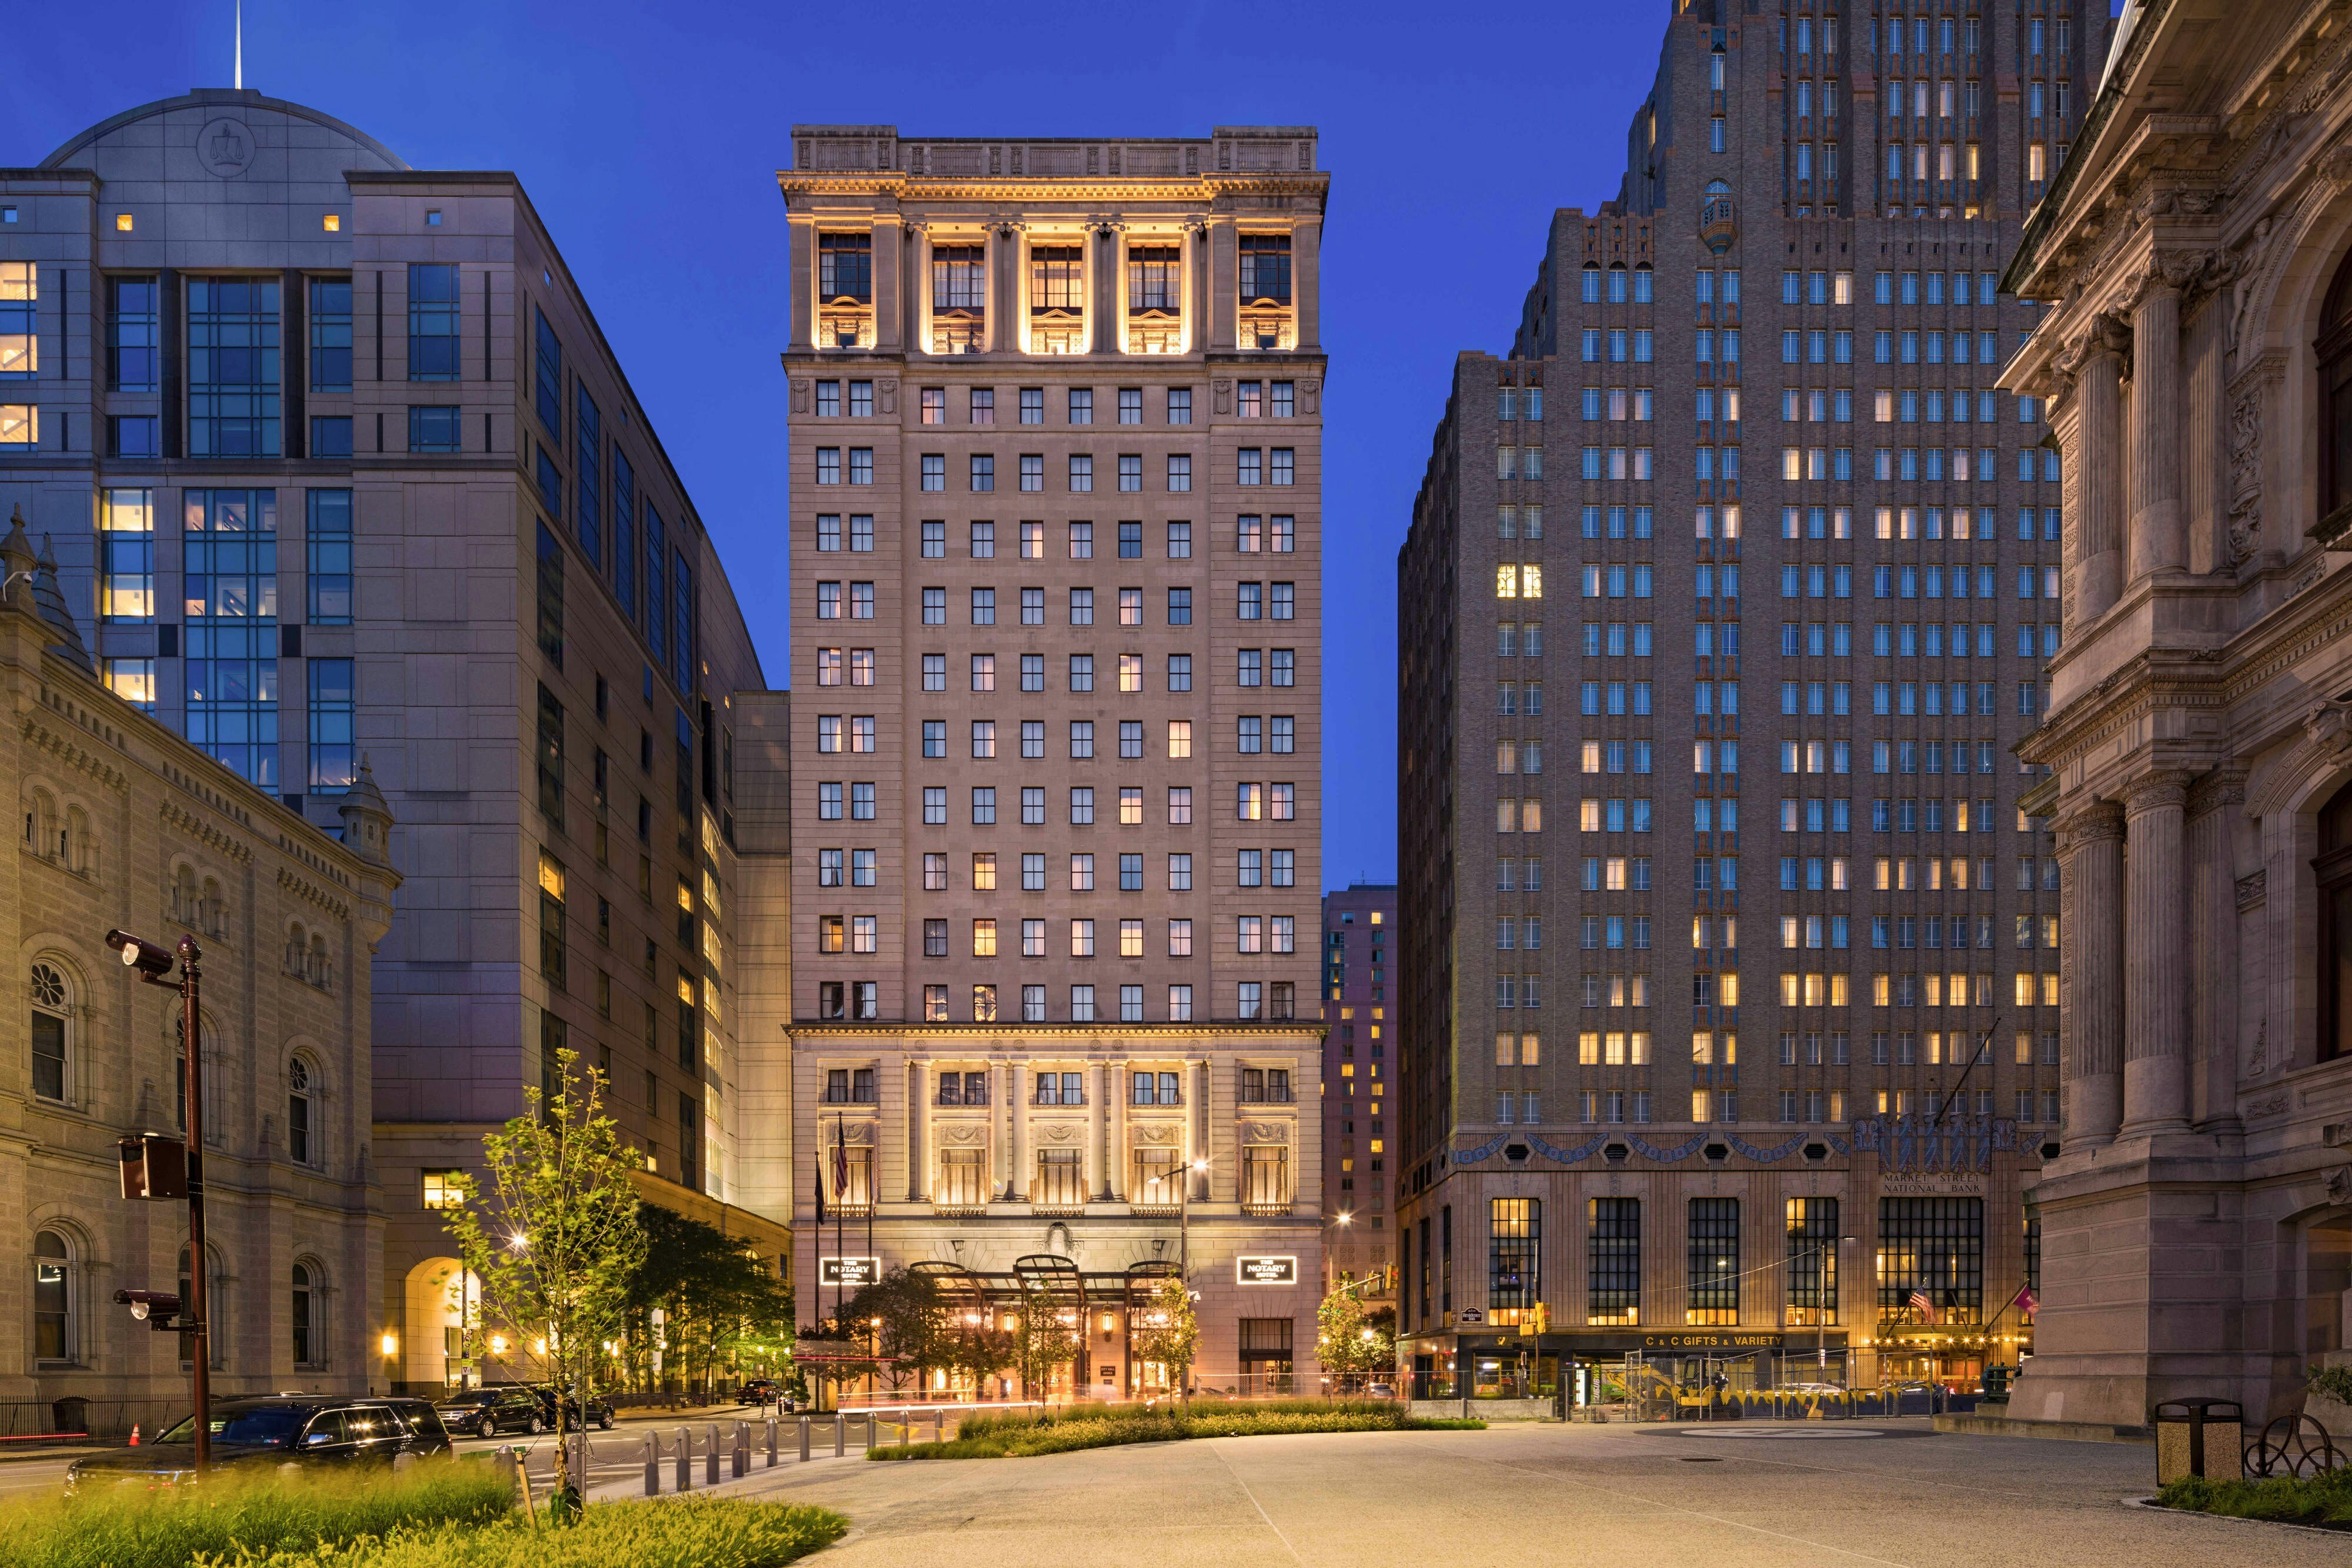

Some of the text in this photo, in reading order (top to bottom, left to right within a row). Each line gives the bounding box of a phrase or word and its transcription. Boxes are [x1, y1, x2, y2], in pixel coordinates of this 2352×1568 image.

[1646, 1337, 1654, 1346] C
[1671, 1337, 1679, 1346] C
[1683, 1337, 1718, 1346] GIFTS
[1734, 1336, 1782, 1345] VARIETY
